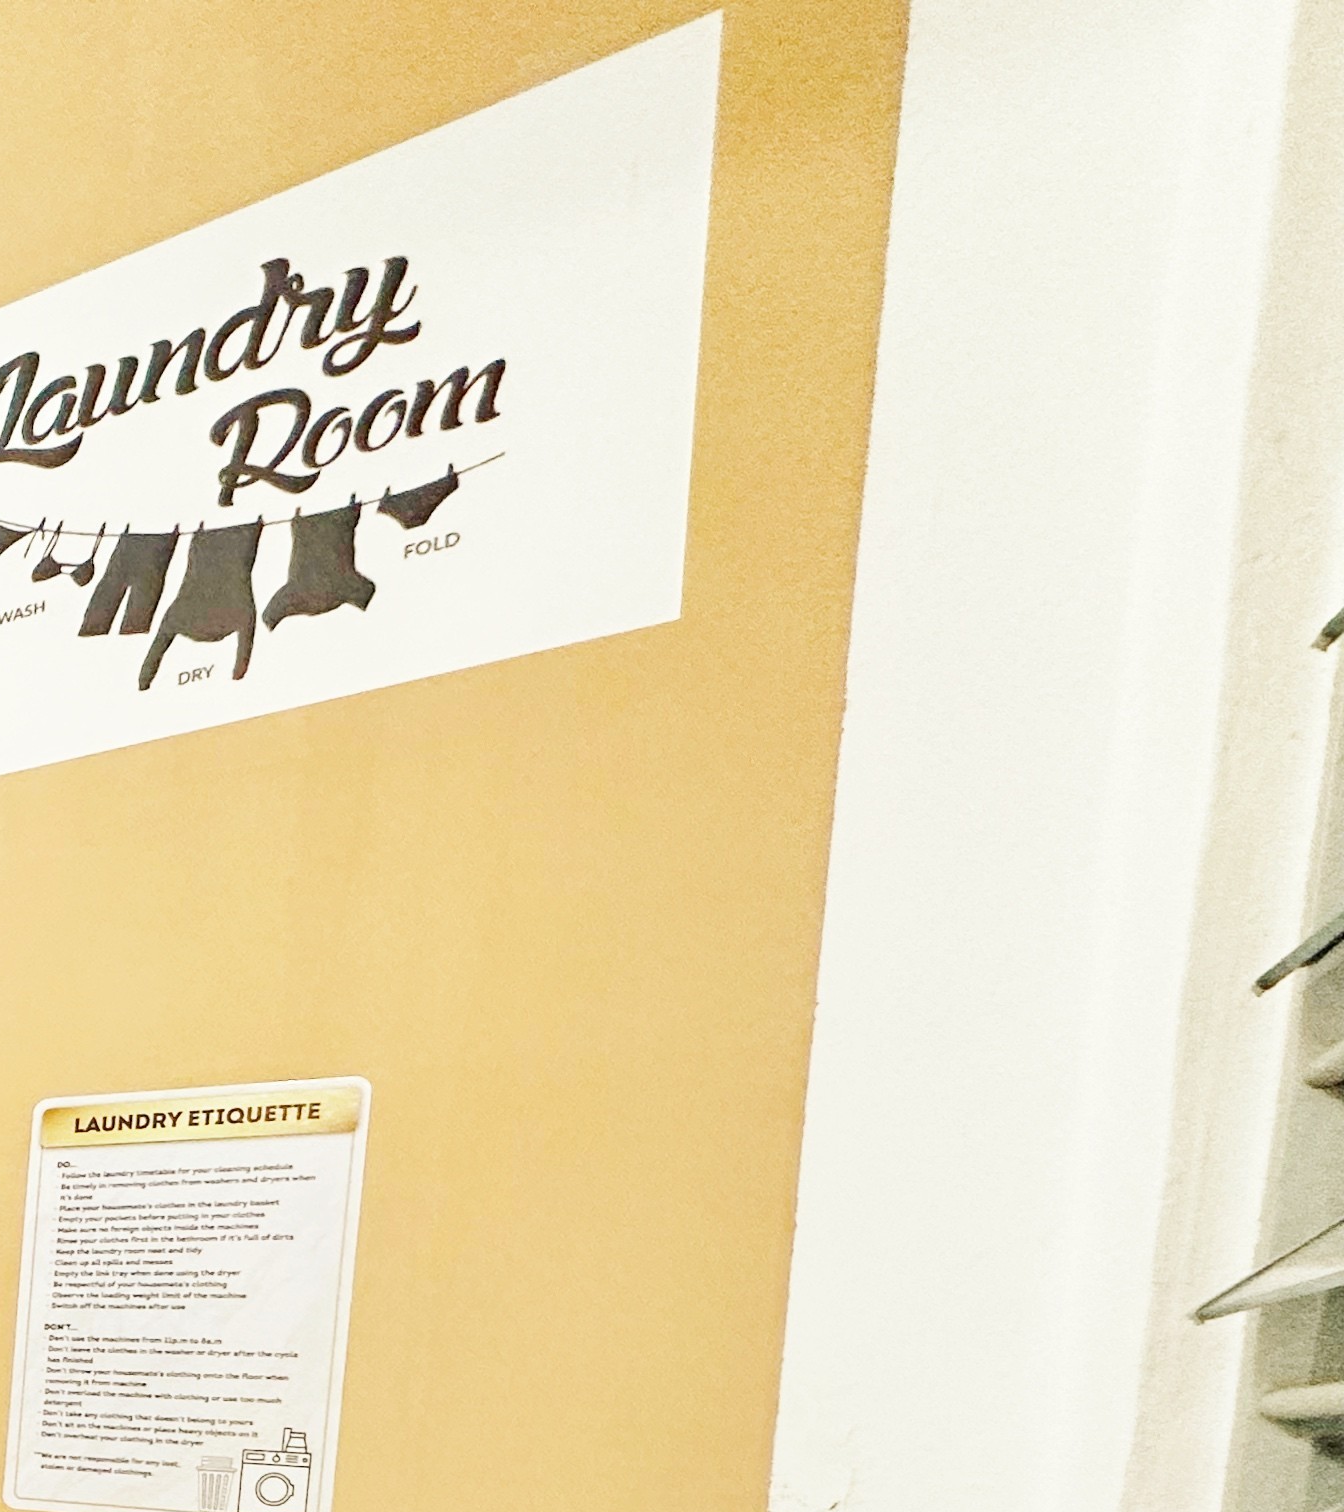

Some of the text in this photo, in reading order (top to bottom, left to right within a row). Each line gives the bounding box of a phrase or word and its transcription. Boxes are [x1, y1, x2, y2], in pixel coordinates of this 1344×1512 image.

[210, 358, 507, 507] Room
[403, 532, 461, 559] FOLD
[178, 664, 215, 686] DRY
[74, 1102, 321, 1133] LAUNDRY ETIQUETTE
